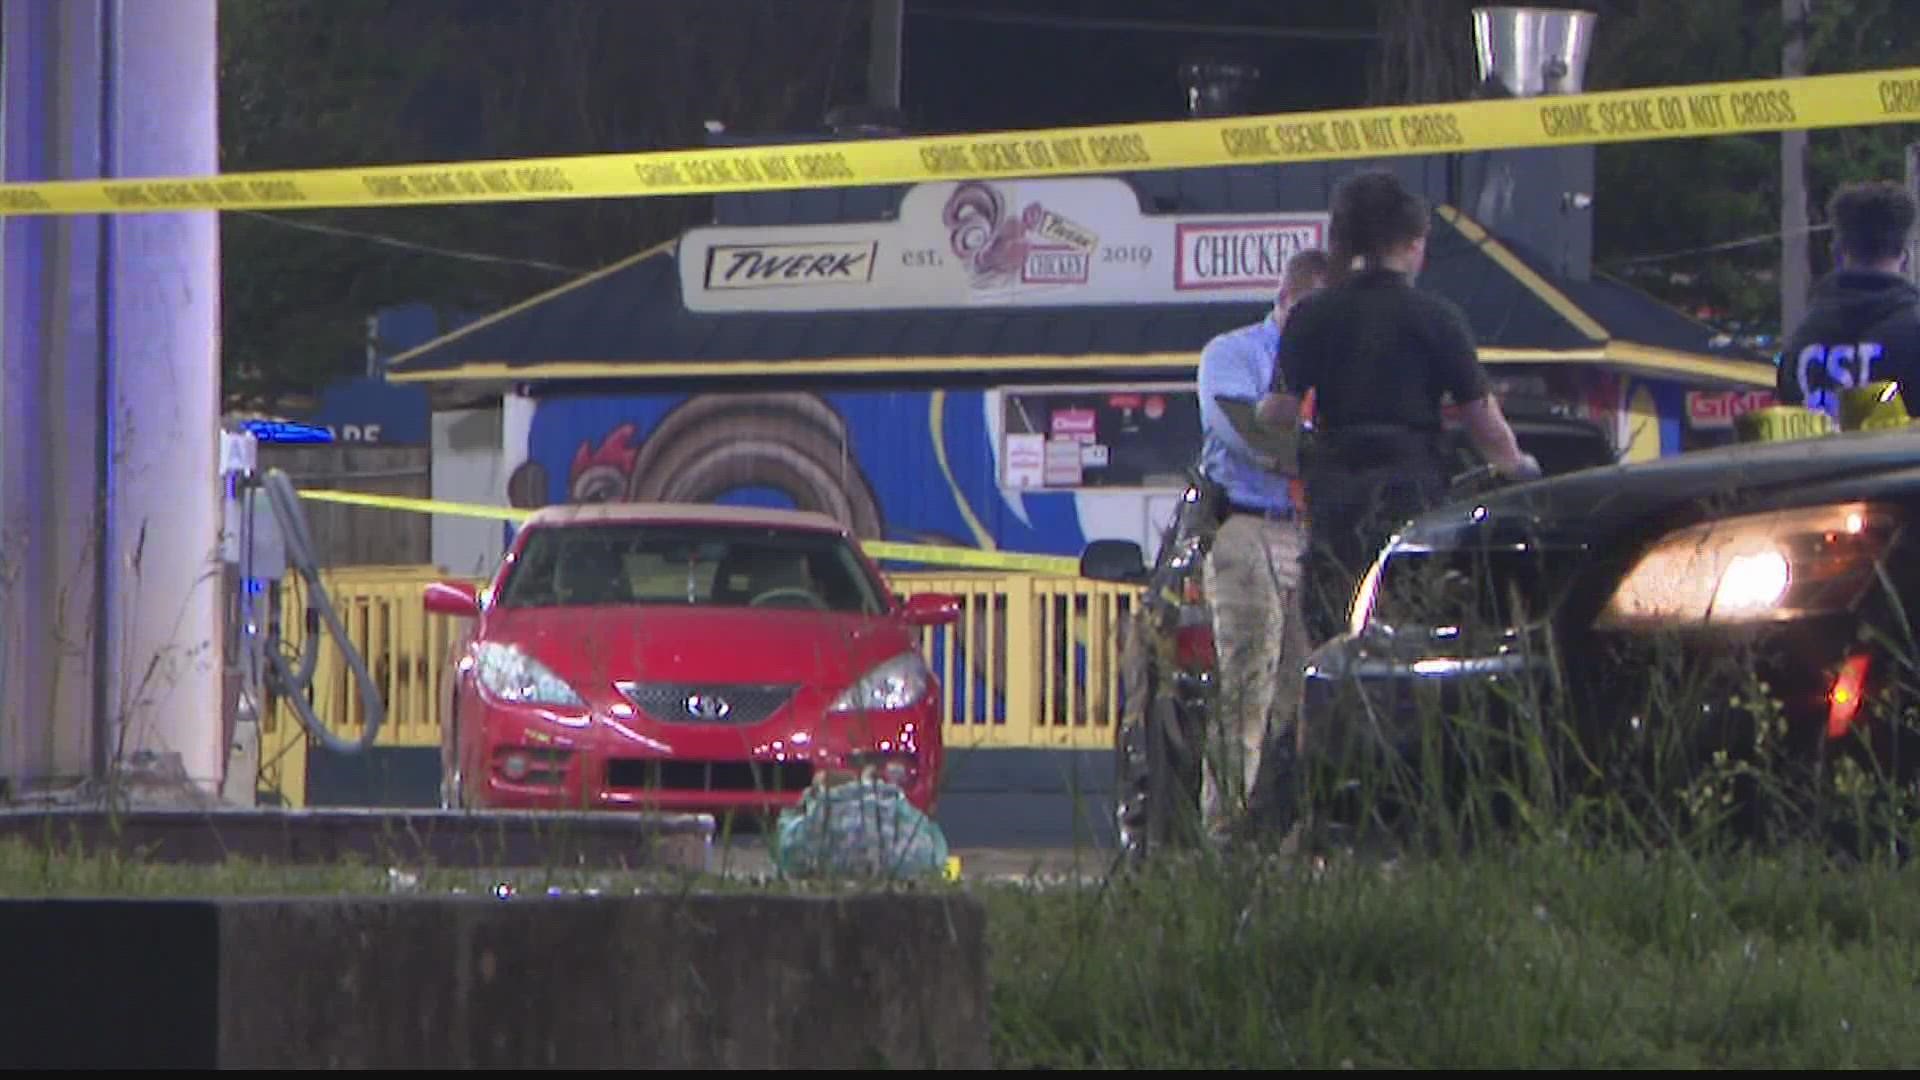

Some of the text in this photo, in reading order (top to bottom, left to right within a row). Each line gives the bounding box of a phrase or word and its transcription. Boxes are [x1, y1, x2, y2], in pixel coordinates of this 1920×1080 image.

[1540, 90, 1796, 136] CRIME SCENE DO NOT CROSS
[1220, 113, 1463, 157] CRIME SCENE DO NOT CROSS
[920, 133, 1150, 173] CRIME SCENE DO NOT CROSS
[725, 251, 866, 280] TWERK
[902, 249, 943, 267] est.
[1102, 245, 1153, 269] 2019
